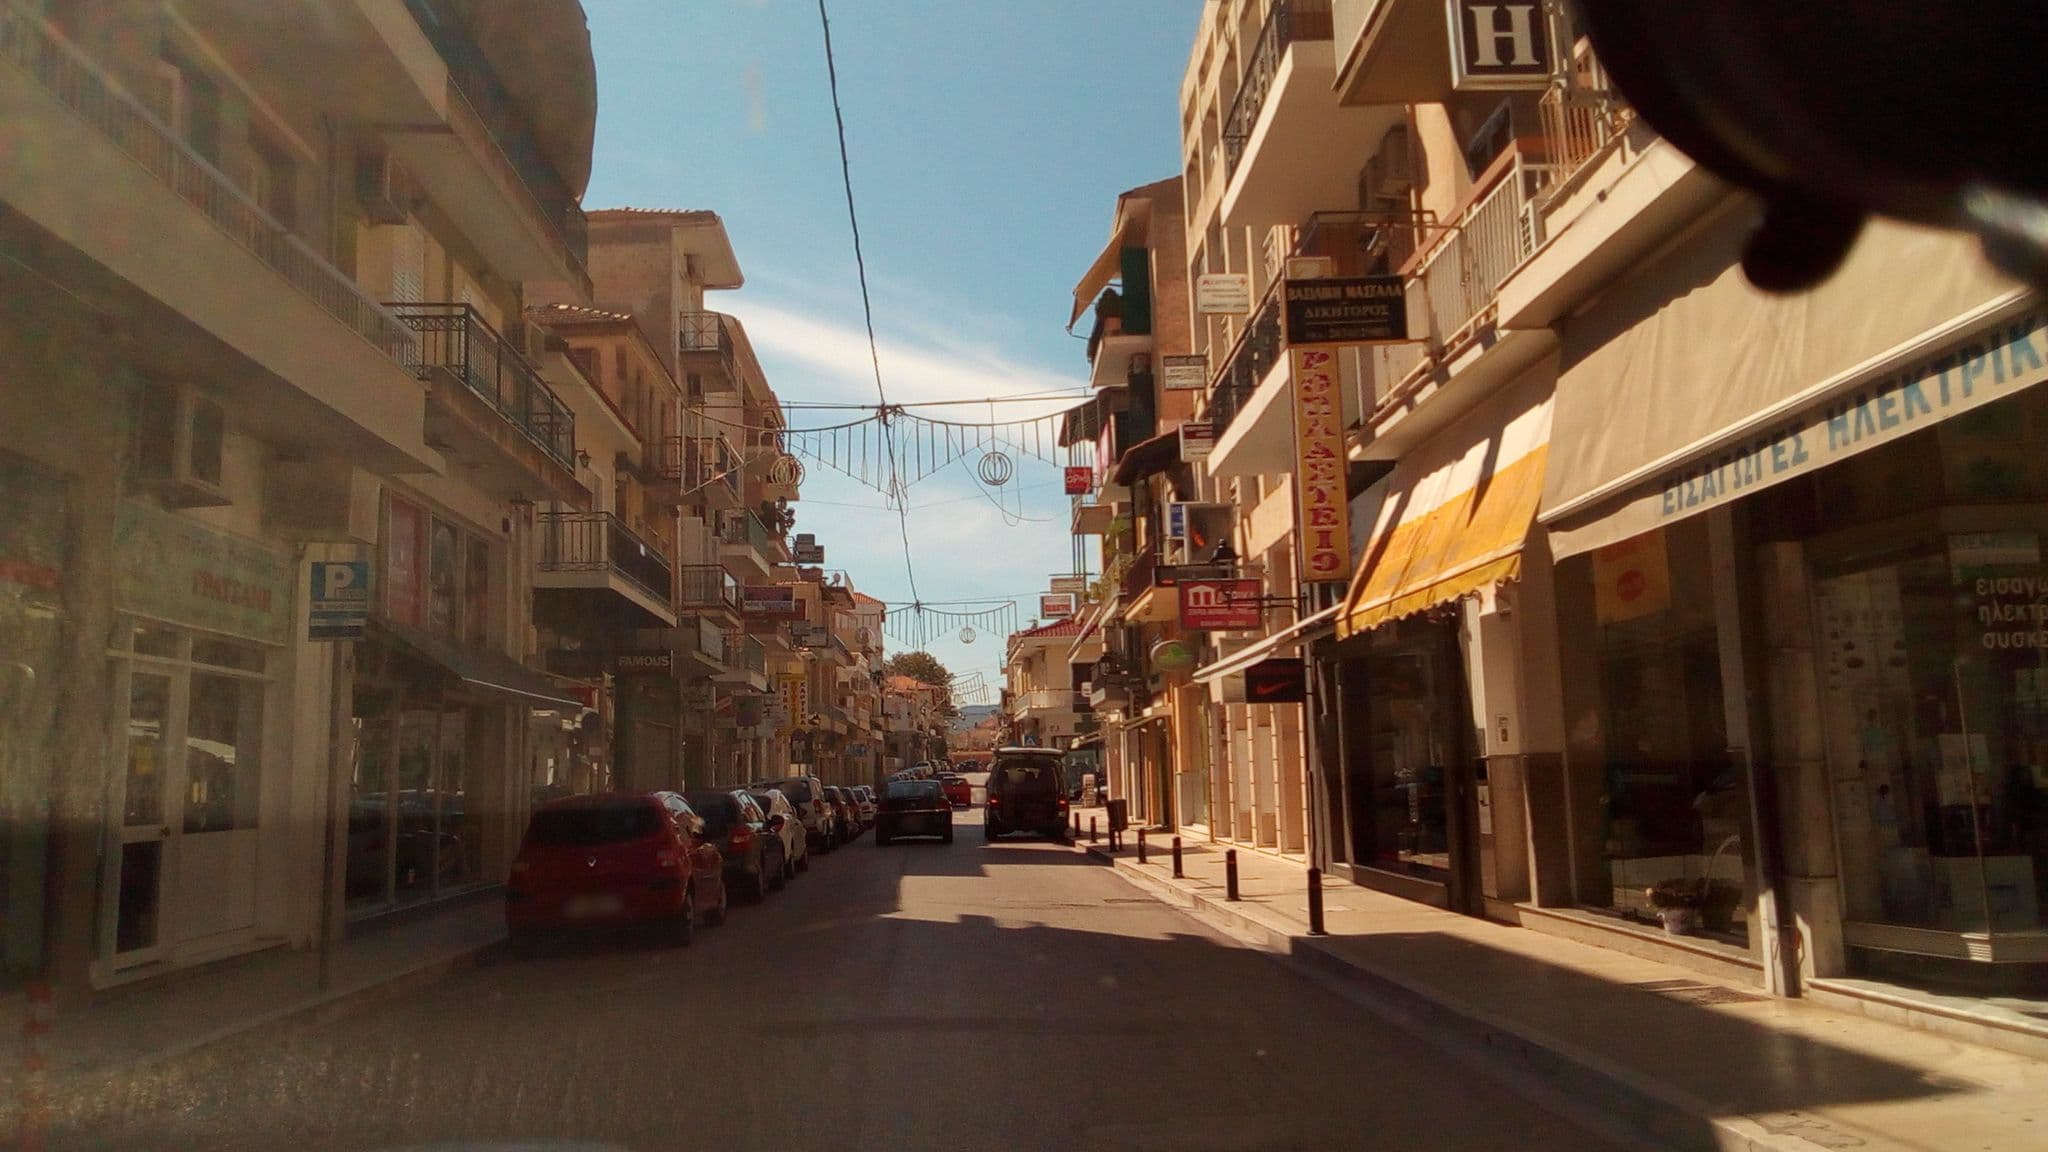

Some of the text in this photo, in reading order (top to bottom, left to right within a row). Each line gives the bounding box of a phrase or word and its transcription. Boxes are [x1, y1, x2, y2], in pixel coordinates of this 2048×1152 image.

[1468, 5, 1540, 66] H
[1304, 304, 1390, 319] ΔΙΚΗΓΟΡΟΣ
[1662, 320, 2048, 516] ΕΙΣΑΓΩΓΕΣ ΗΛΕΚΤΡΙΚ
[1301, 351, 1341, 573] ΡΟΠΛΑΣΤΕΙΟ
[618, 655, 670, 666] FAMOUS
